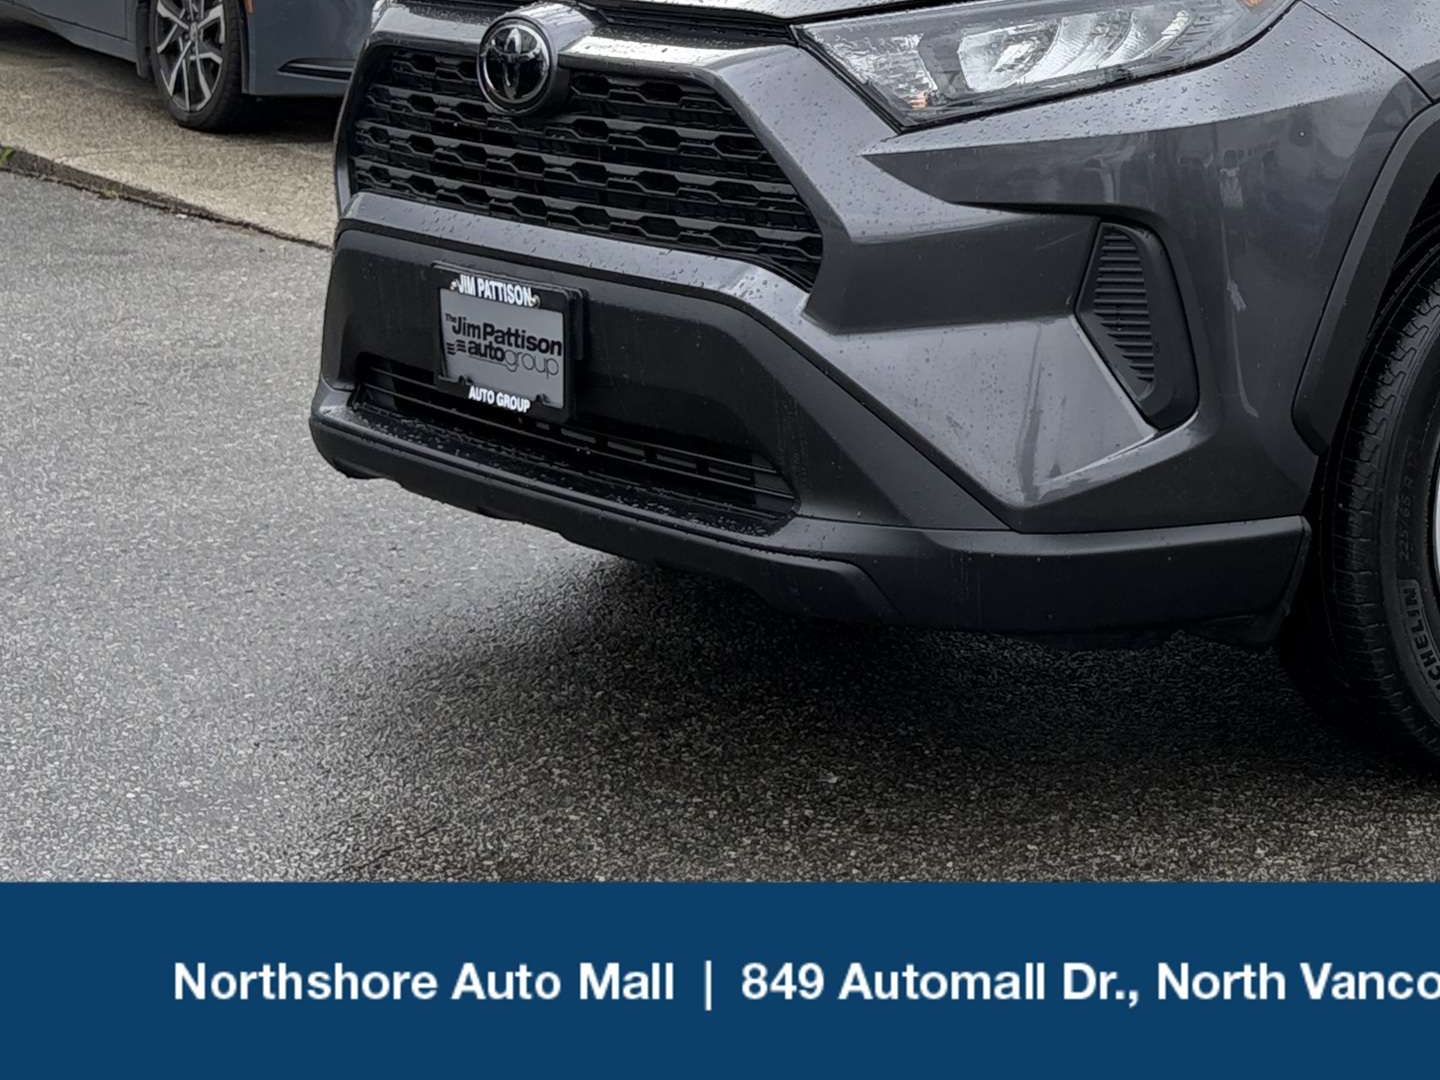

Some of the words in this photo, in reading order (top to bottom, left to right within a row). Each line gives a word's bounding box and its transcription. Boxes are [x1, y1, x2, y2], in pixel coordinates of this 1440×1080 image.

[458, 274, 476, 296] JIM
[477, 278, 534, 307] PATTISON
[451, 316, 481, 339] Jim
[482, 322, 562, 356] Pattison
[469, 385, 495, 405] AUTO
[496, 391, 531, 413] GROUP
